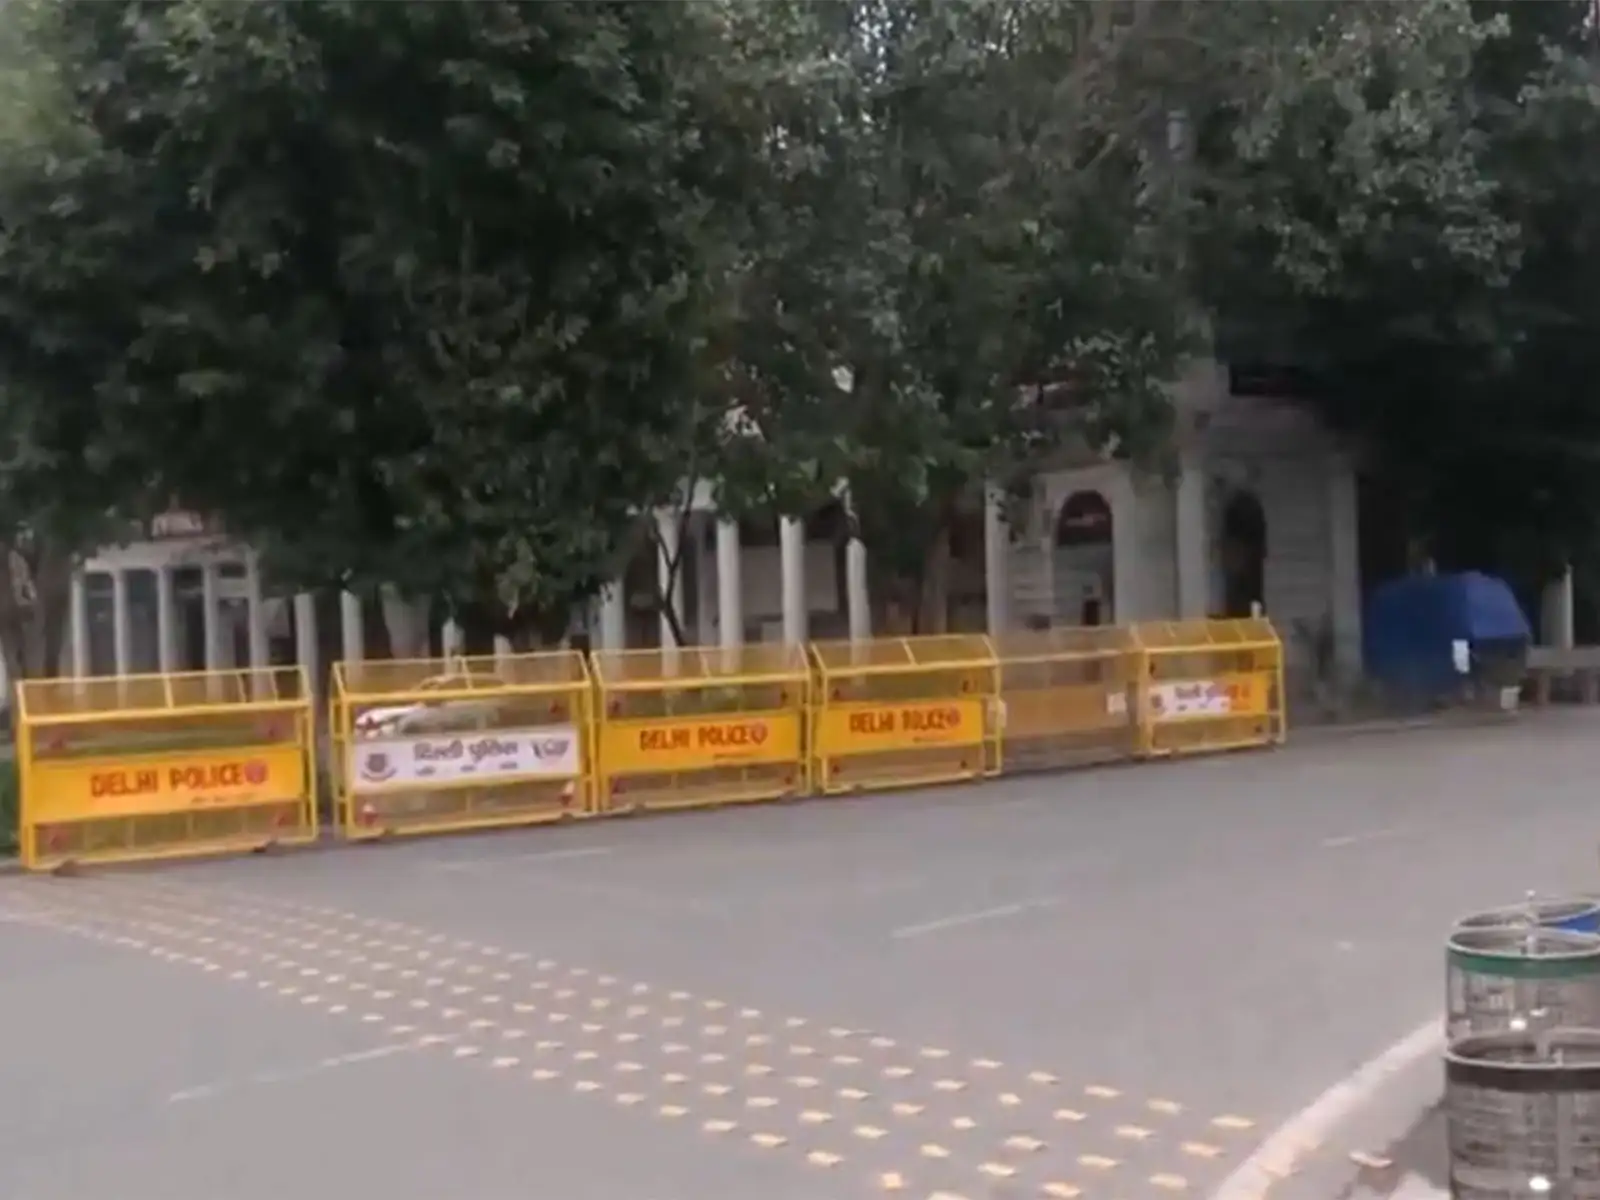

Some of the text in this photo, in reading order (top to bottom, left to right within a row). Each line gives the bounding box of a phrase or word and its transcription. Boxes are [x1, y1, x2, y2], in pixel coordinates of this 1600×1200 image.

[849, 709, 945, 734] DELHI POLICE
[639, 726, 749, 751] DELHI POLICE
[90, 766, 159, 798] DELHI
[170, 762, 243, 792] POLICE
